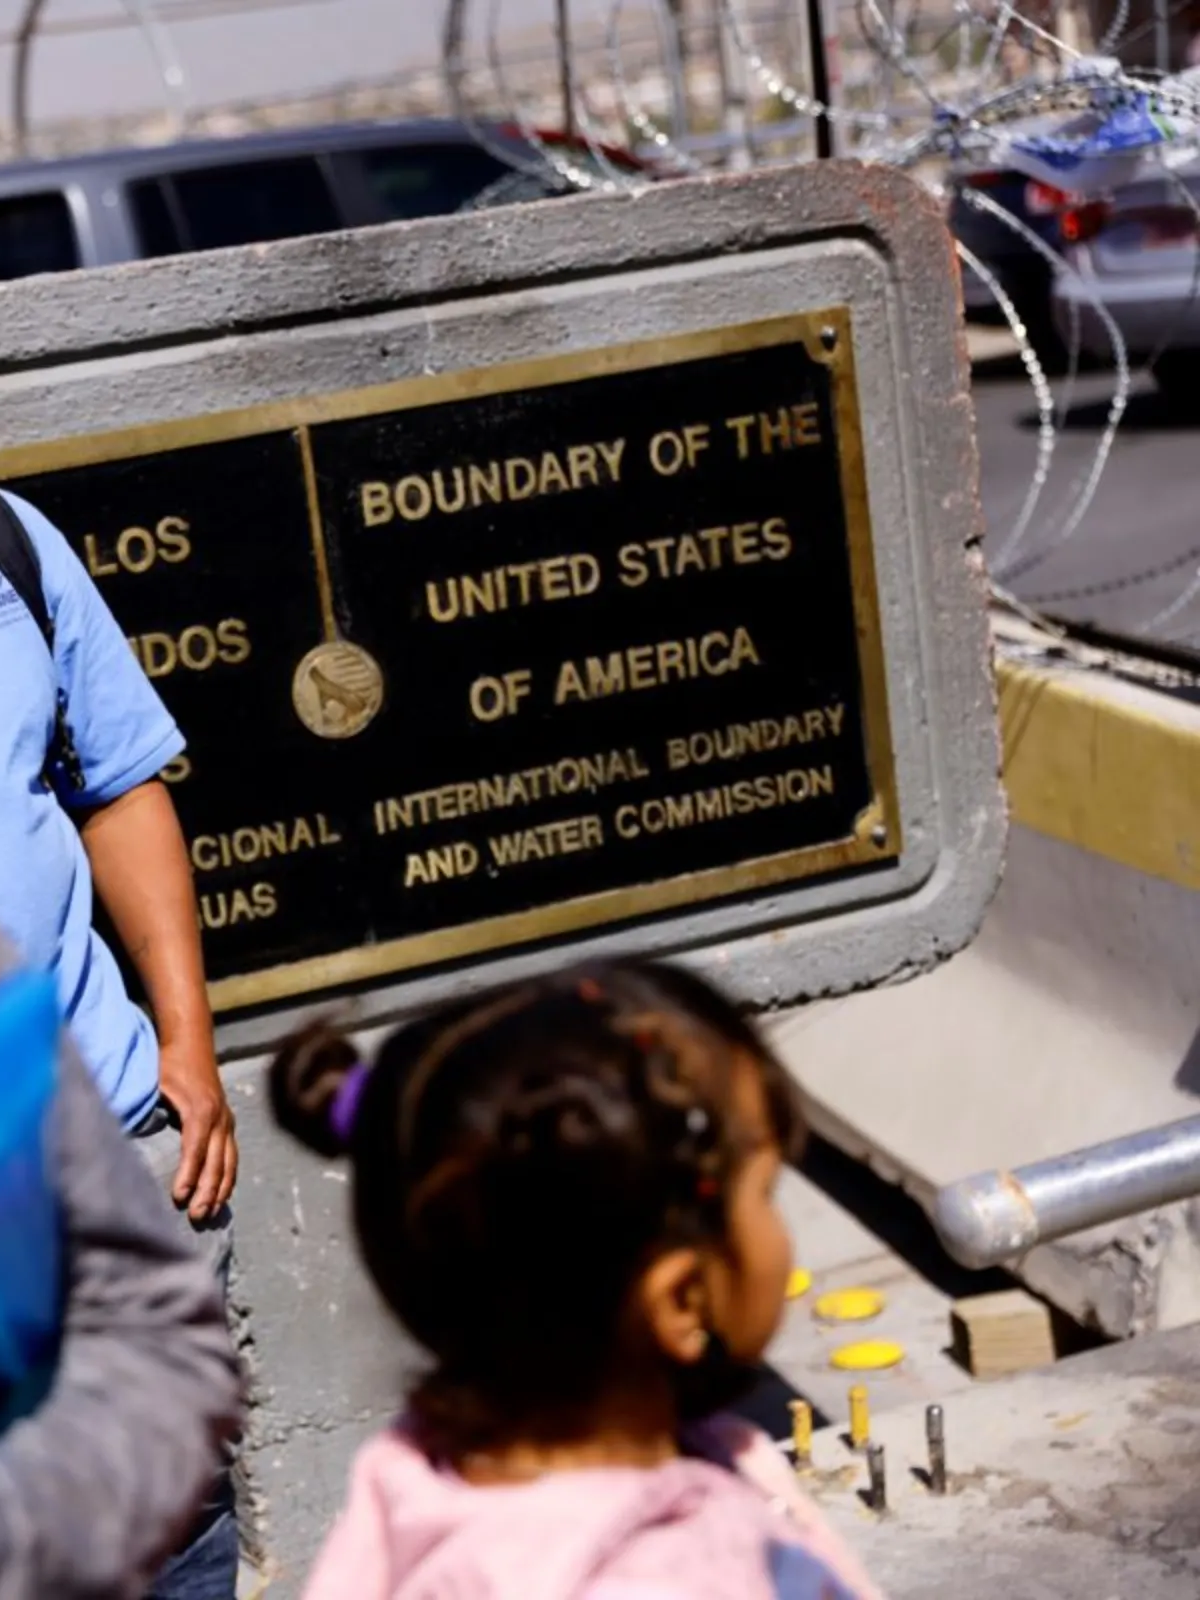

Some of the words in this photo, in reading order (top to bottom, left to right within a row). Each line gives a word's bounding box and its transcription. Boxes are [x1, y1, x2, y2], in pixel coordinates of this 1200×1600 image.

[361, 439, 626, 527] BOUNDARY
[649, 425, 709, 476] OF
[726, 402, 821, 460] THE
[84, 515, 191, 577] LOS
[425, 553, 600, 623] UNITED
[617, 518, 792, 586] STATES
[469, 671, 532, 722] OF
[555, 627, 762, 704] AMERICA
[374, 749, 650, 834] INTERNATIONAL
[667, 703, 845, 768] BOUNDARY
[404, 841, 479, 888] AND
[490, 815, 604, 867] WATER
[615, 767, 834, 836] COMMISSION
